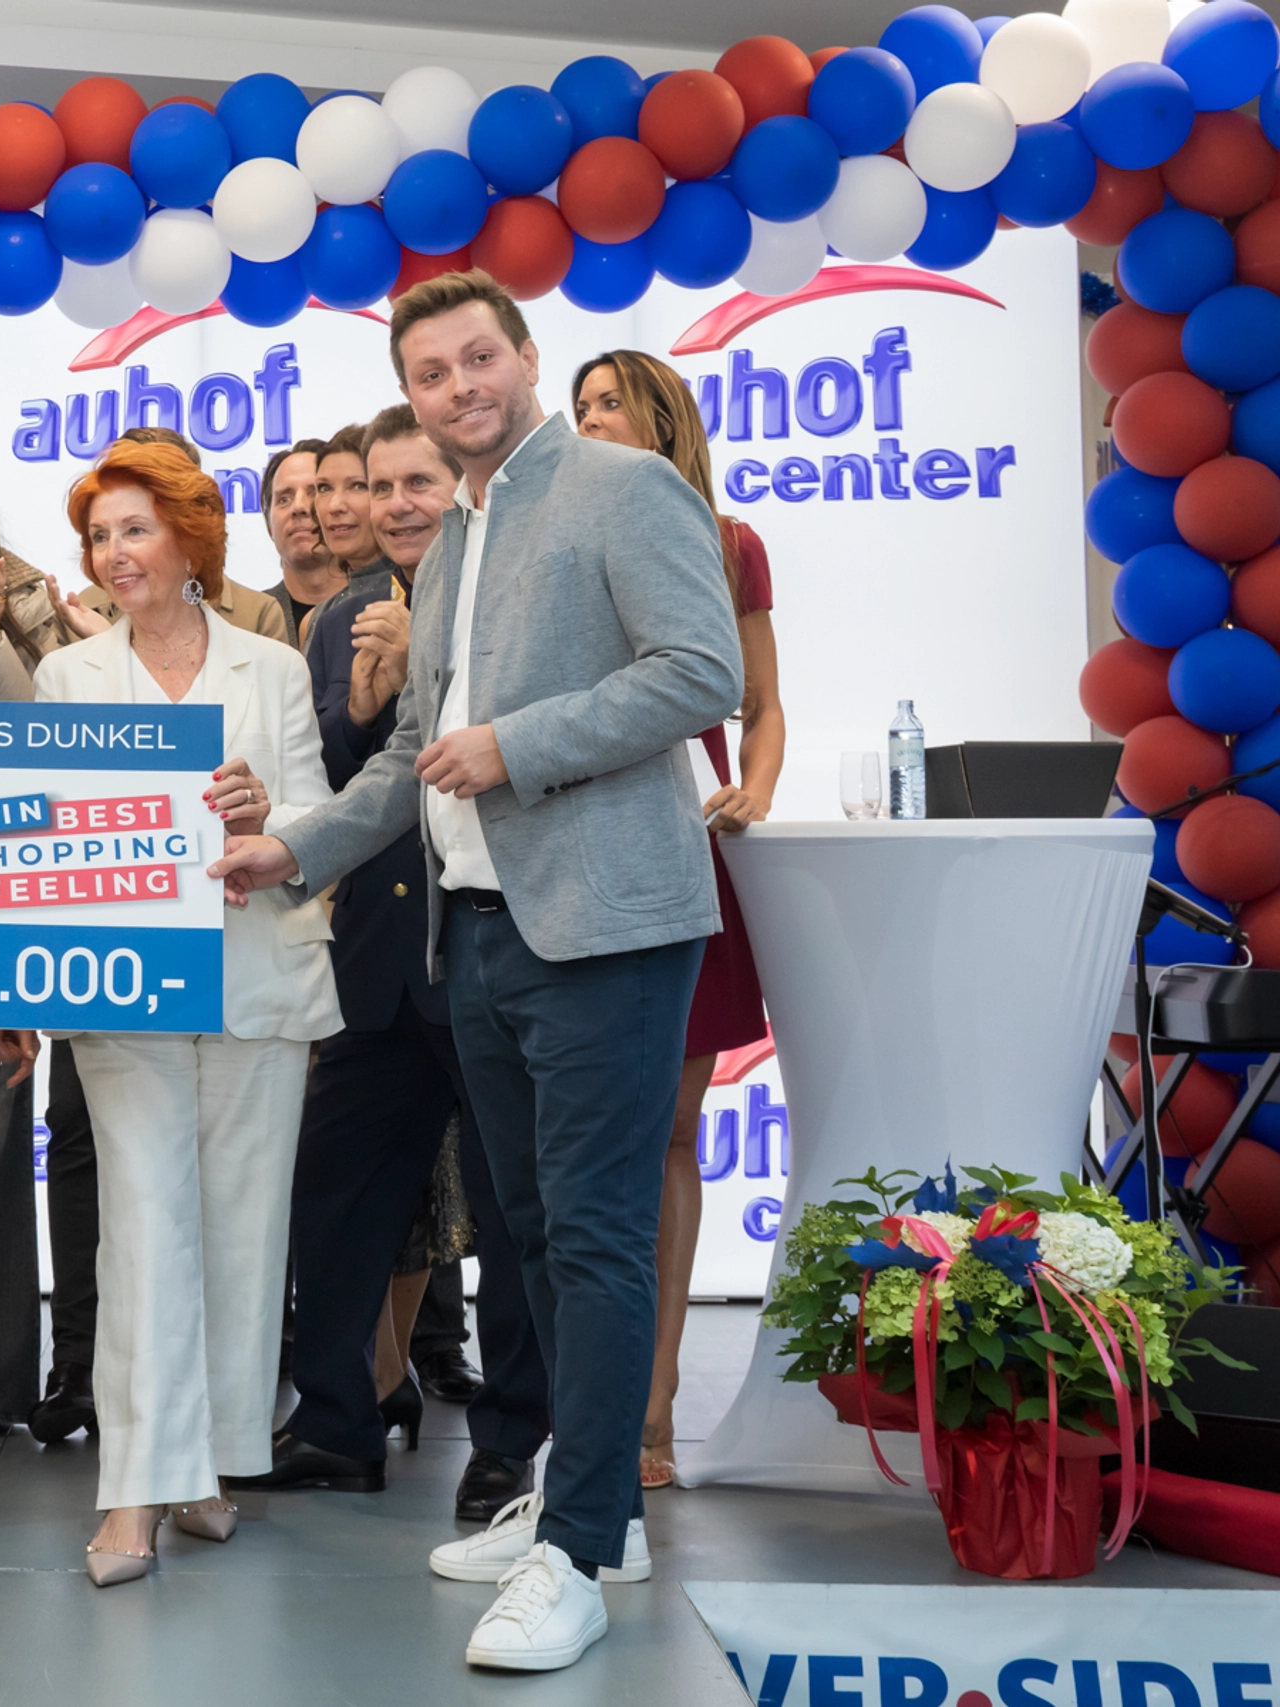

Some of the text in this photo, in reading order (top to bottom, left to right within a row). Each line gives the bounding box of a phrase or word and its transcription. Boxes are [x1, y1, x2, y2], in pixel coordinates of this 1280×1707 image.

[683, 325, 912, 442] uhof
[725, 437, 1016, 503] center
[27, 722, 177, 750] DUNKEL
[56, 801, 166, 830] BEST
